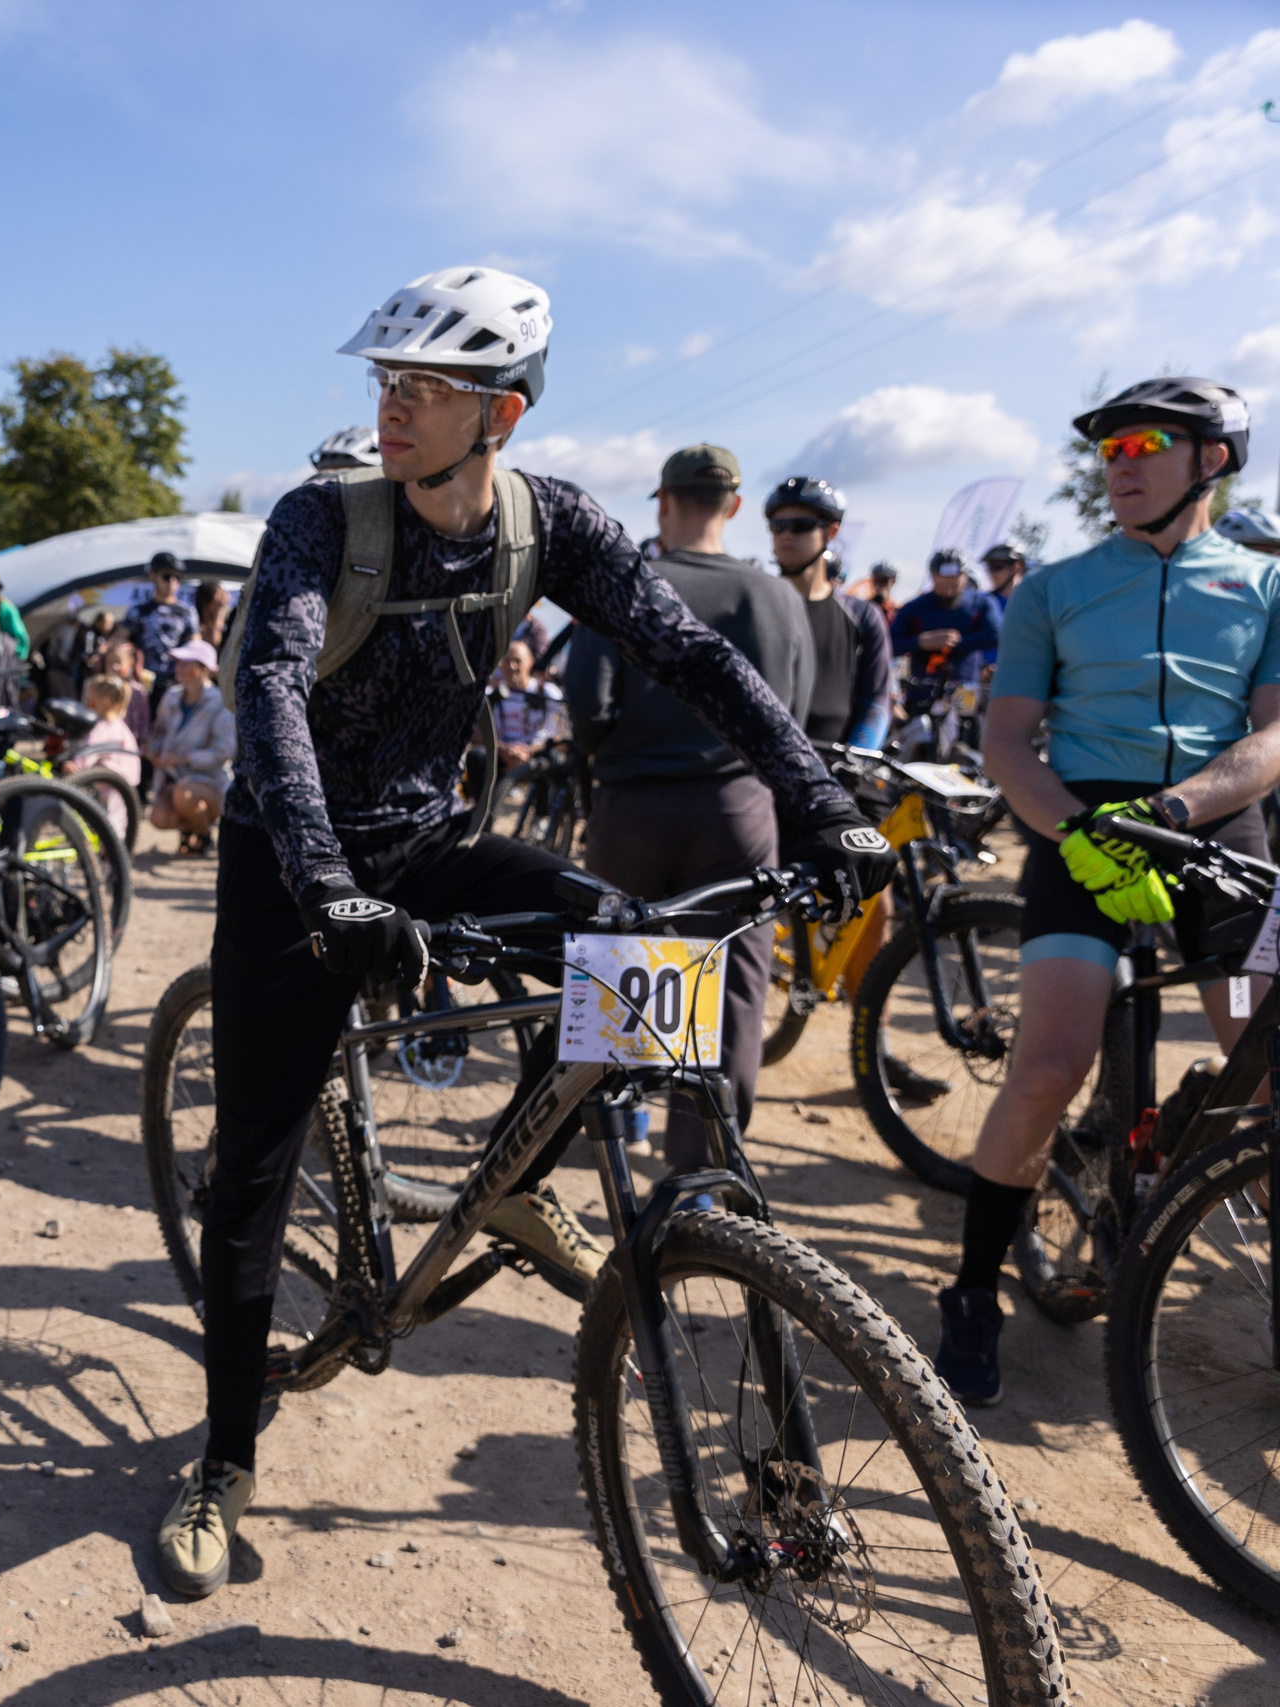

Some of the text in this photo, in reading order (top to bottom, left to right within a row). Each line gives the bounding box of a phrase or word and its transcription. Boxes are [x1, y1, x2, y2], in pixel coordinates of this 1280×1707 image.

[520, 318, 537, 343] 90
[494, 361, 528, 385] SMITH
[620, 966, 682, 1035] 90
[450, 1075, 560, 1230] JAMIS
